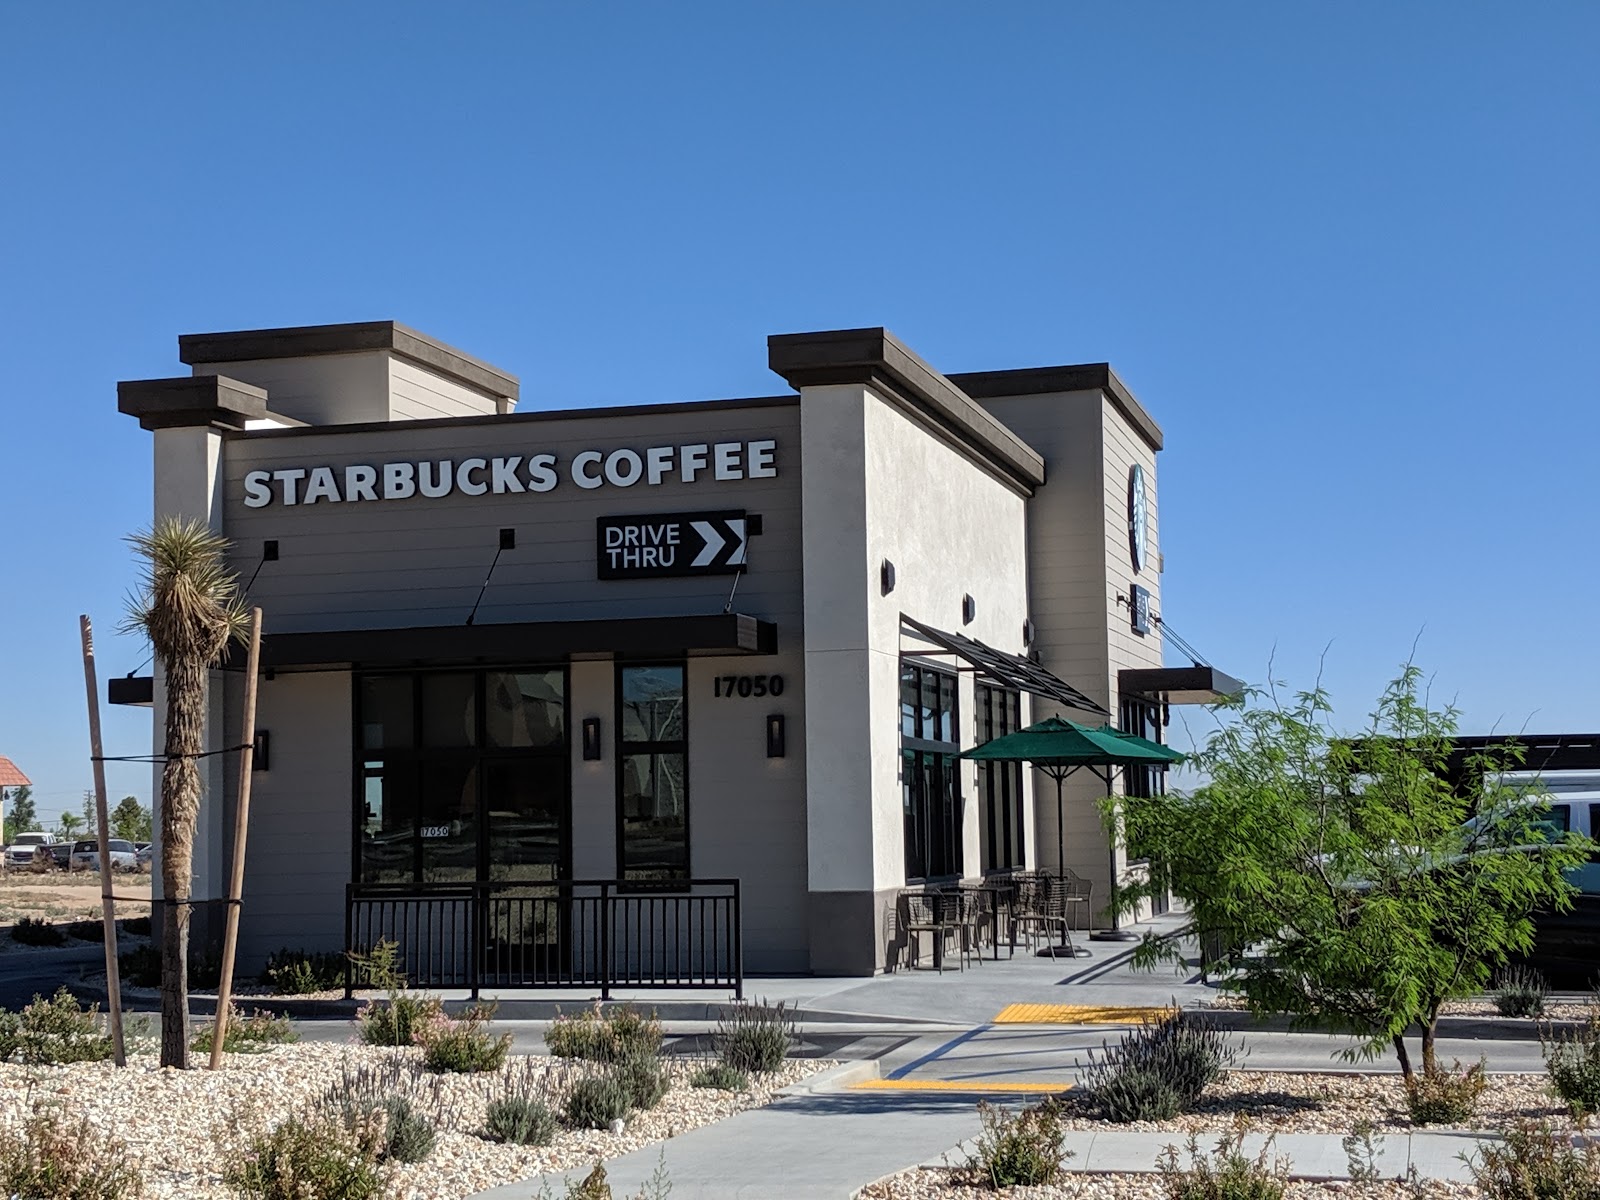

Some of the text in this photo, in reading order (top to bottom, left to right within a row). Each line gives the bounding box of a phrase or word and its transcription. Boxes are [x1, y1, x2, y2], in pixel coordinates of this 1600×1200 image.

[243, 439, 778, 509] STARBUCKS COFFEE
[605, 523, 681, 548] DRIVE
[606, 545, 675, 569] THRU
[714, 674, 784, 698] 17050
[421, 826, 449, 837] 17050
